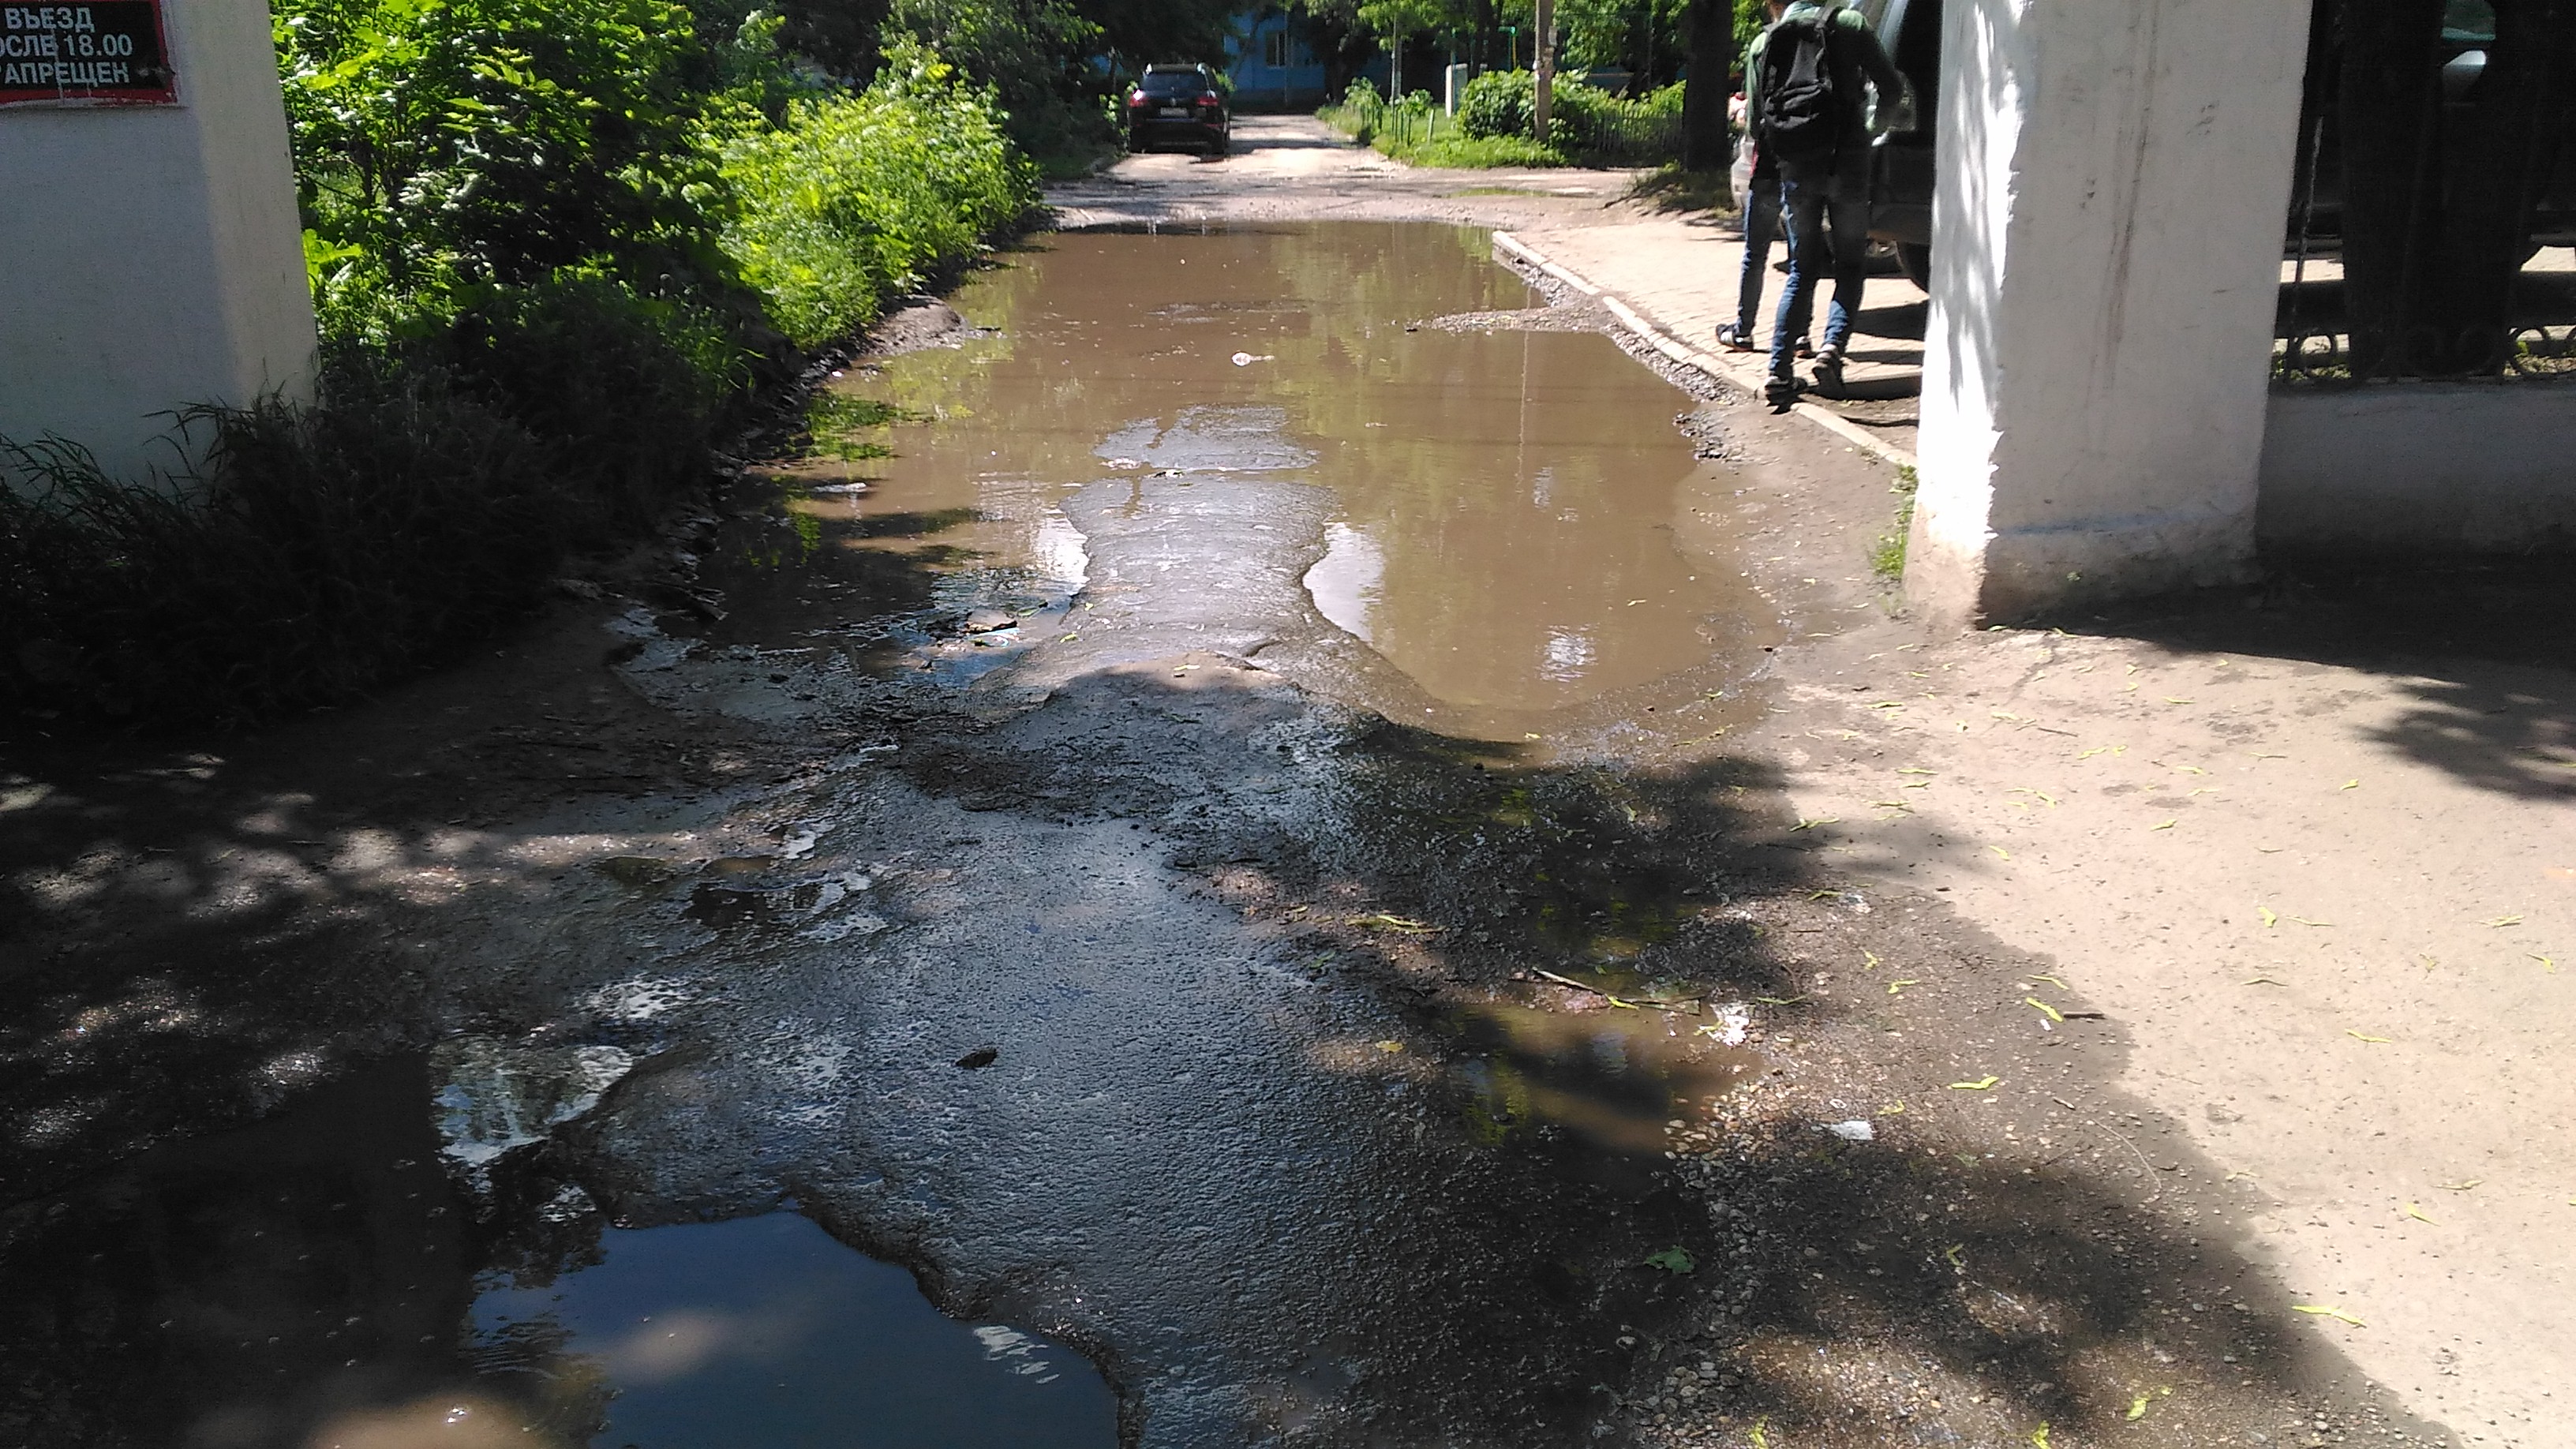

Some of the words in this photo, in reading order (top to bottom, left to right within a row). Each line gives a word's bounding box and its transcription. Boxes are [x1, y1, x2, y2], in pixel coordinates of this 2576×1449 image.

[5, 7, 95, 33] ВЪЕЗД
[64, 34, 133, 56] 18.00
[0, 62, 130, 88] АПРЕЩЕН
